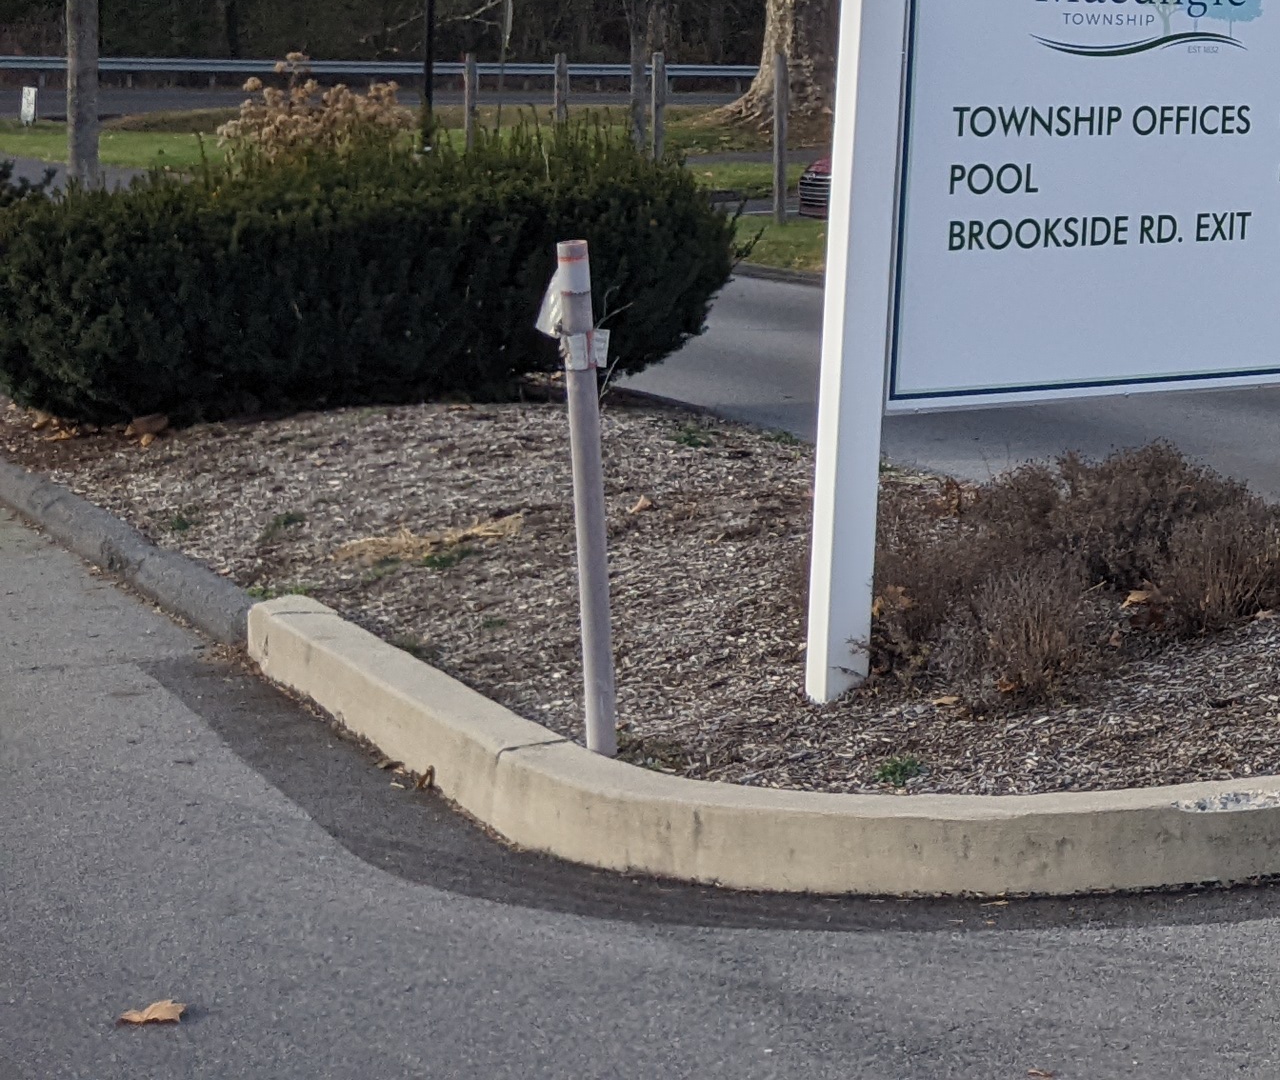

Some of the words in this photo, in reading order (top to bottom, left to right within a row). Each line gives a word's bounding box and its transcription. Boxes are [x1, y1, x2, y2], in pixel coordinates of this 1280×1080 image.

[1063, 12, 1155, 27] TOWNSHIP
[1187, 45, 1202, 54] EST
[953, 105, 1122, 137] TOWNSHIP
[1132, 105, 1251, 136] OFFICES
[949, 163, 1039, 195] POOL
[948, 216, 1129, 251] BROOKSIDE
[1139, 214, 1183, 245] RD.
[1196, 211, 1252, 242] EXIT
